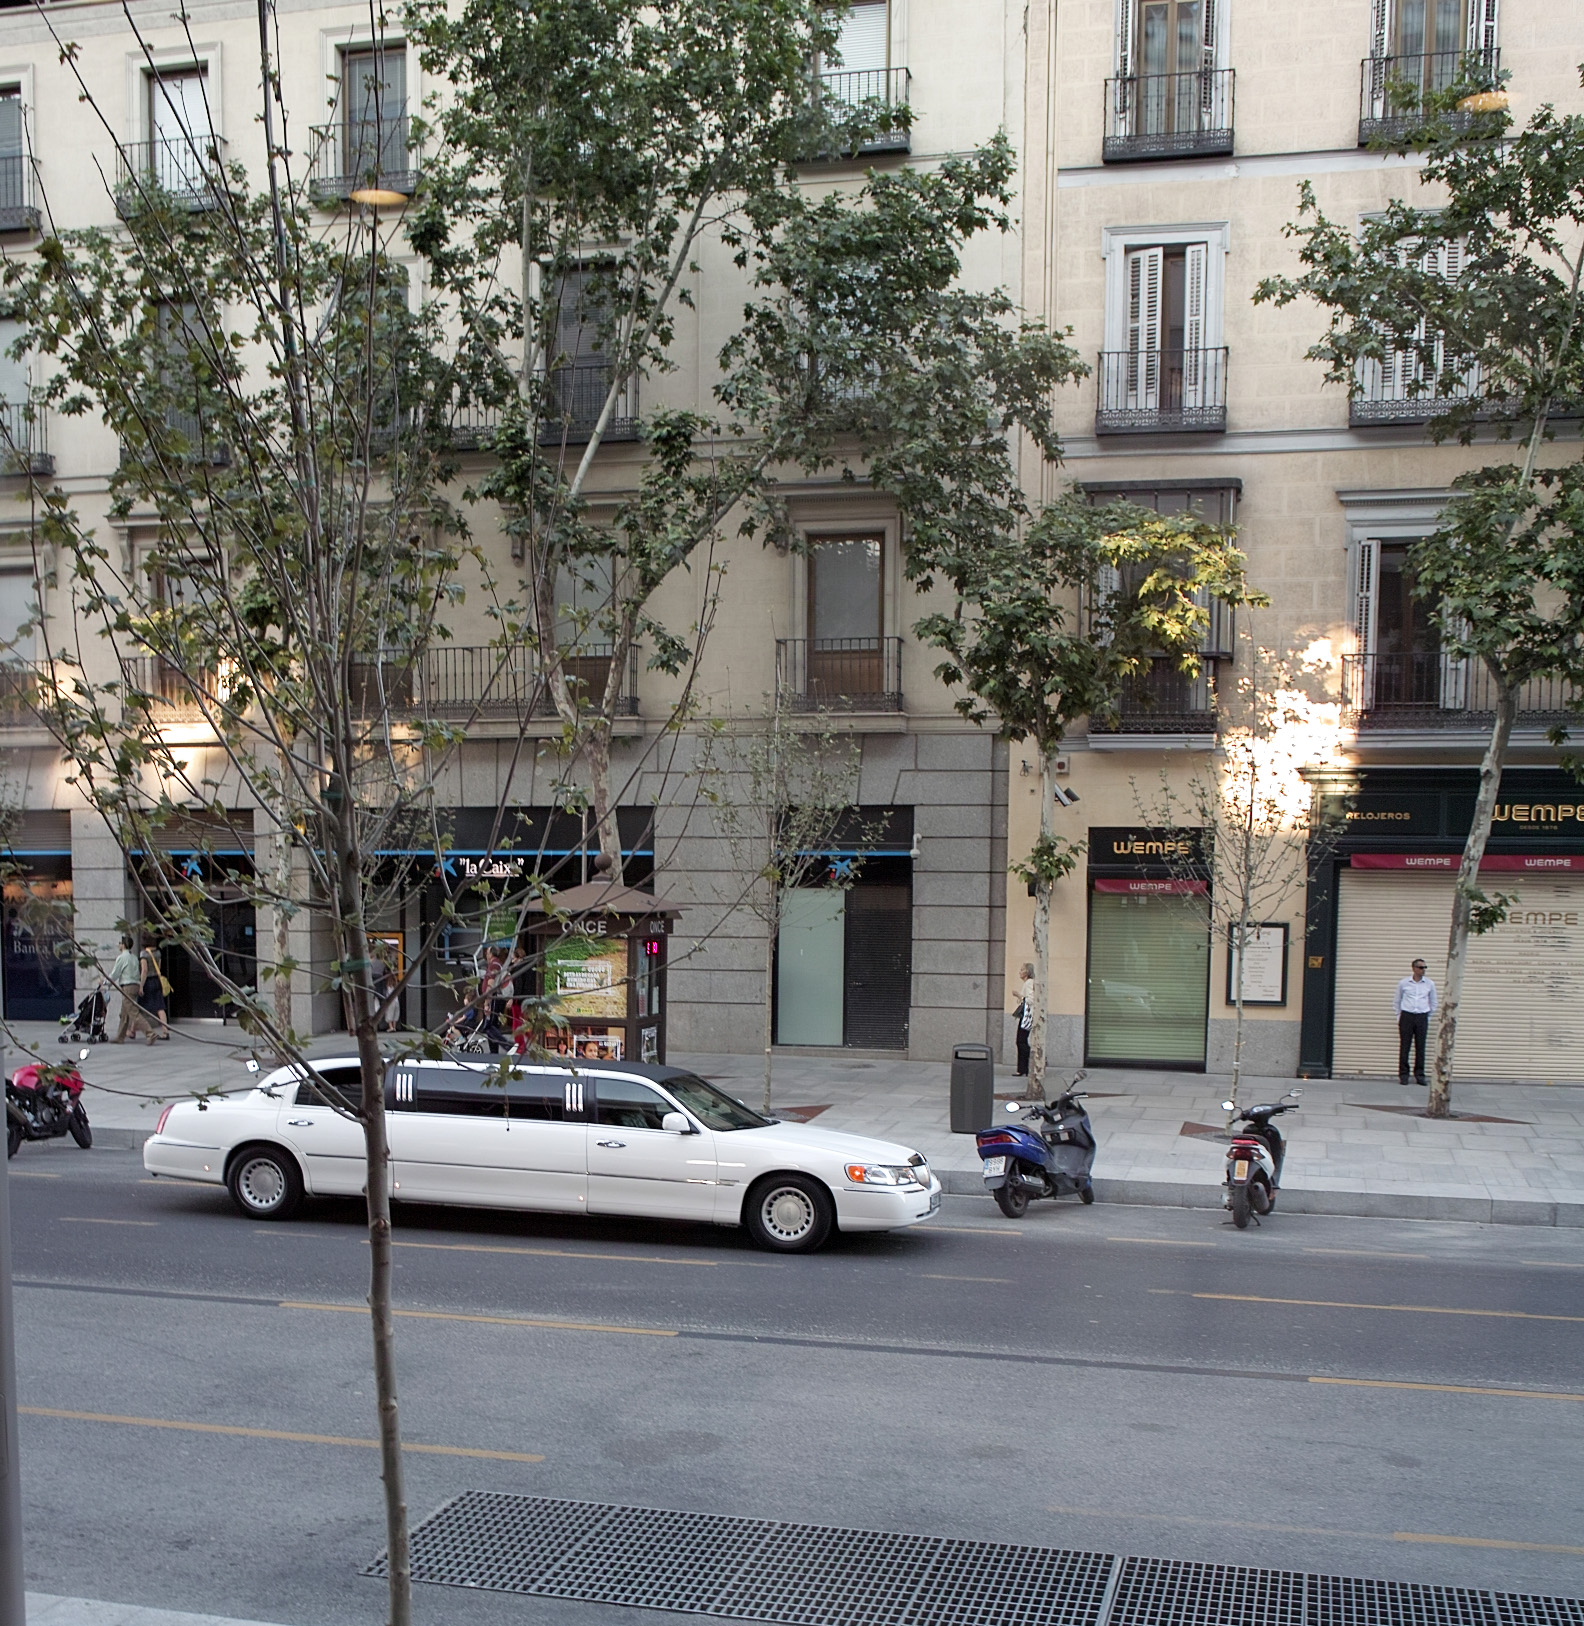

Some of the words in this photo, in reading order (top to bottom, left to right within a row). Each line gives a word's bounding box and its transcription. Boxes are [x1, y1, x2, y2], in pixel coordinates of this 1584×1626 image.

[1345, 811, 1411, 820] RELOJEROS
[1113, 841, 1190, 854] WEMPE
[1405, 858, 1451, 866] WEMPE
[1525, 858, 1572, 867] WEMPE
[1129, 883, 1172, 891] WEMPE
[1497, 911, 1579, 926] EMPE
[650, 920, 665, 934] ONCE
[13, 940, 48, 954] Bana
